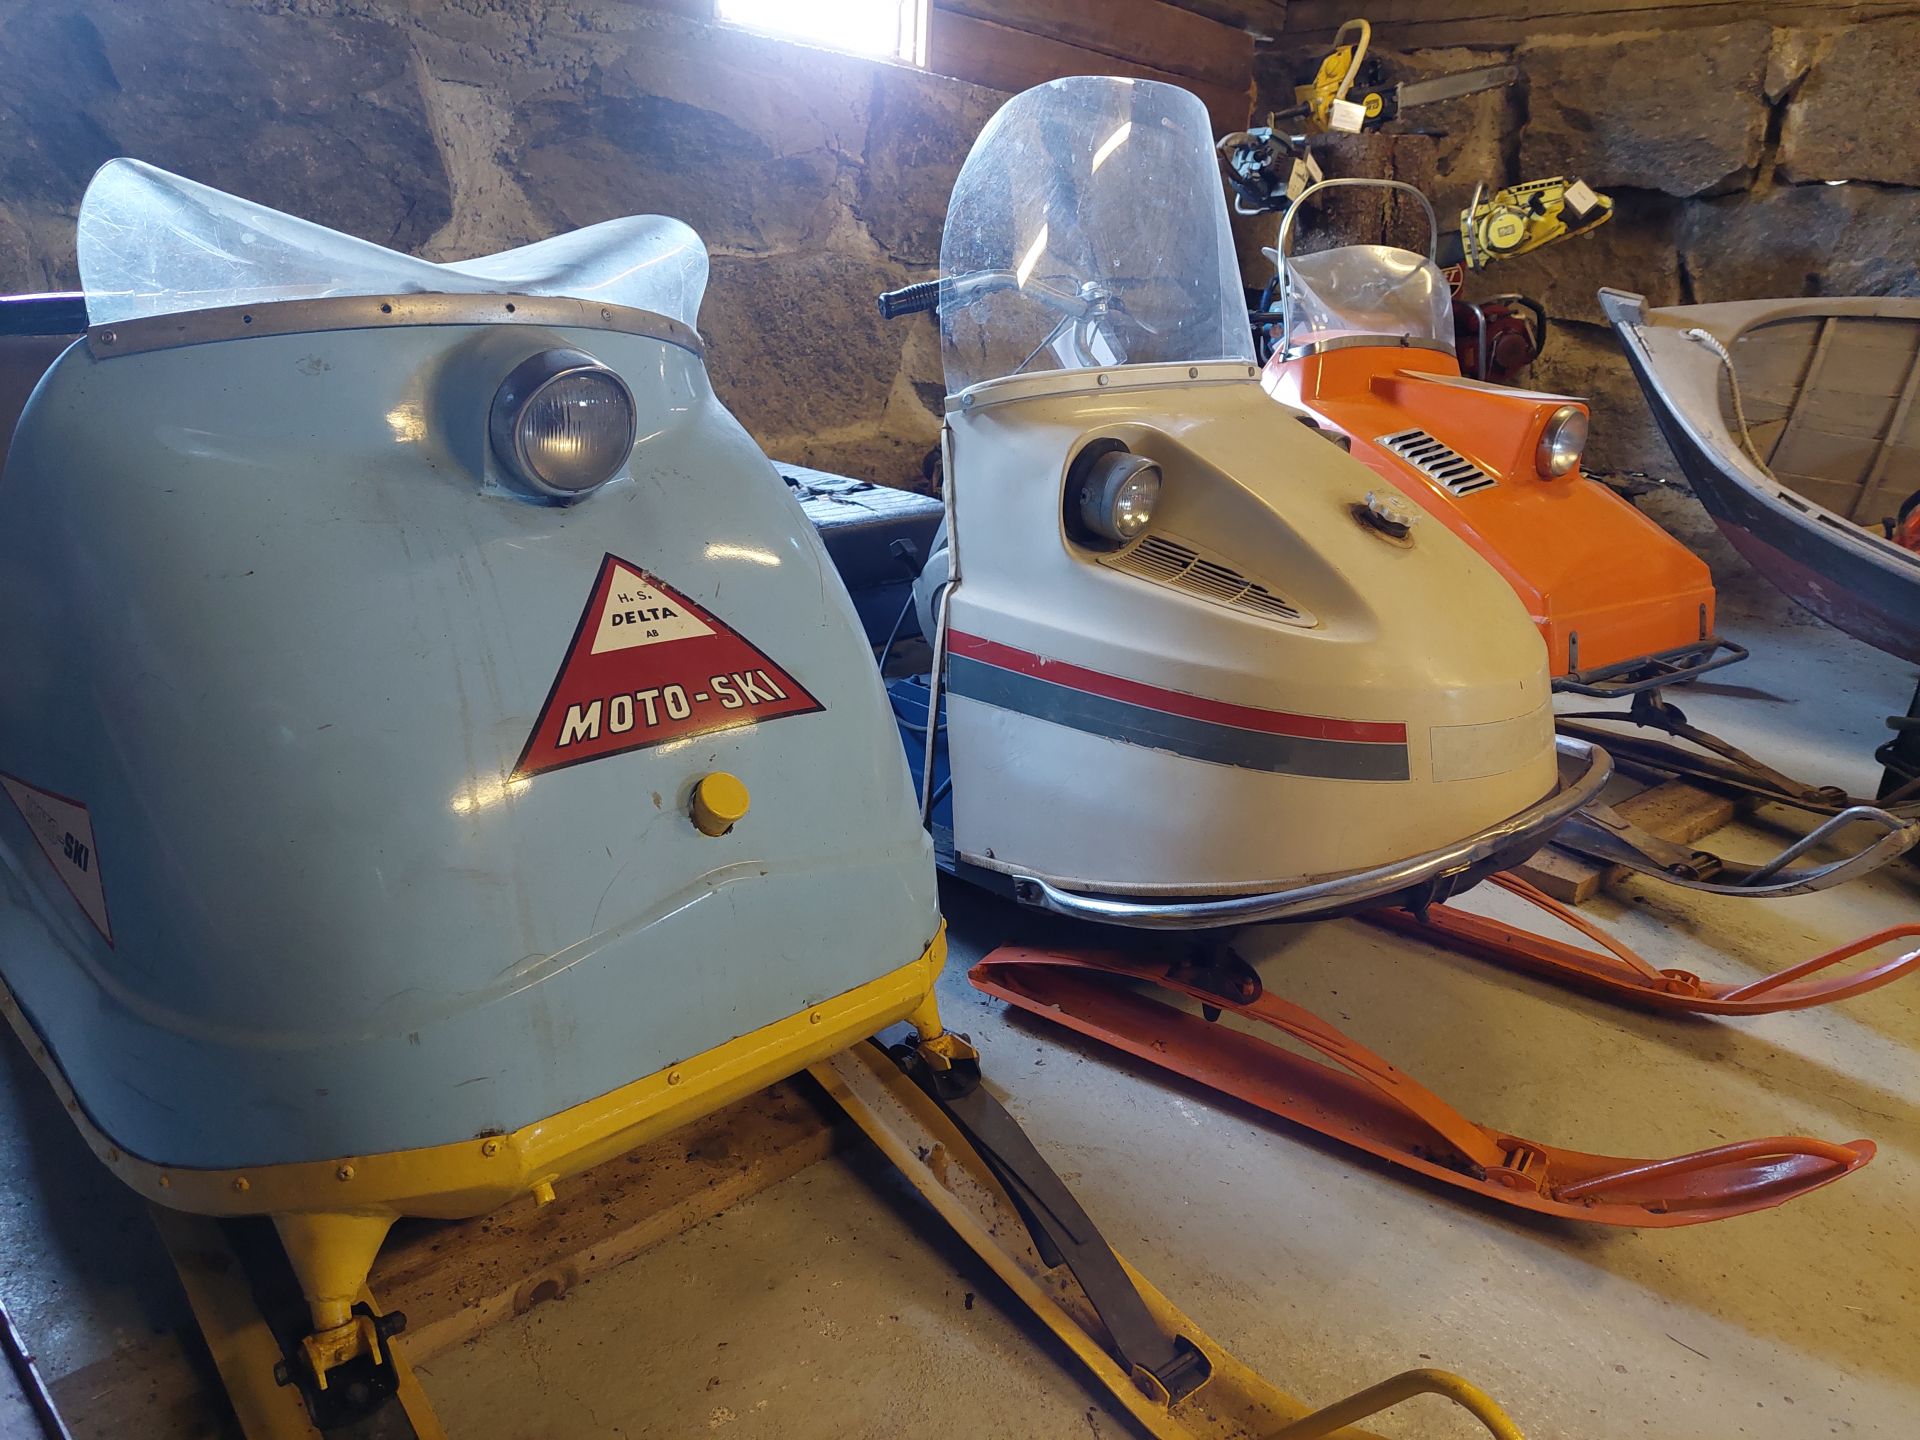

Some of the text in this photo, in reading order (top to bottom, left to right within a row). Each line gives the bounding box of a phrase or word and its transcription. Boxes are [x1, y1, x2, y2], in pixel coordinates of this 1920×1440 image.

[611, 606, 679, 627] DELTA
[646, 629, 659, 638] AB
[556, 670, 789, 748] MOTO-SKI
